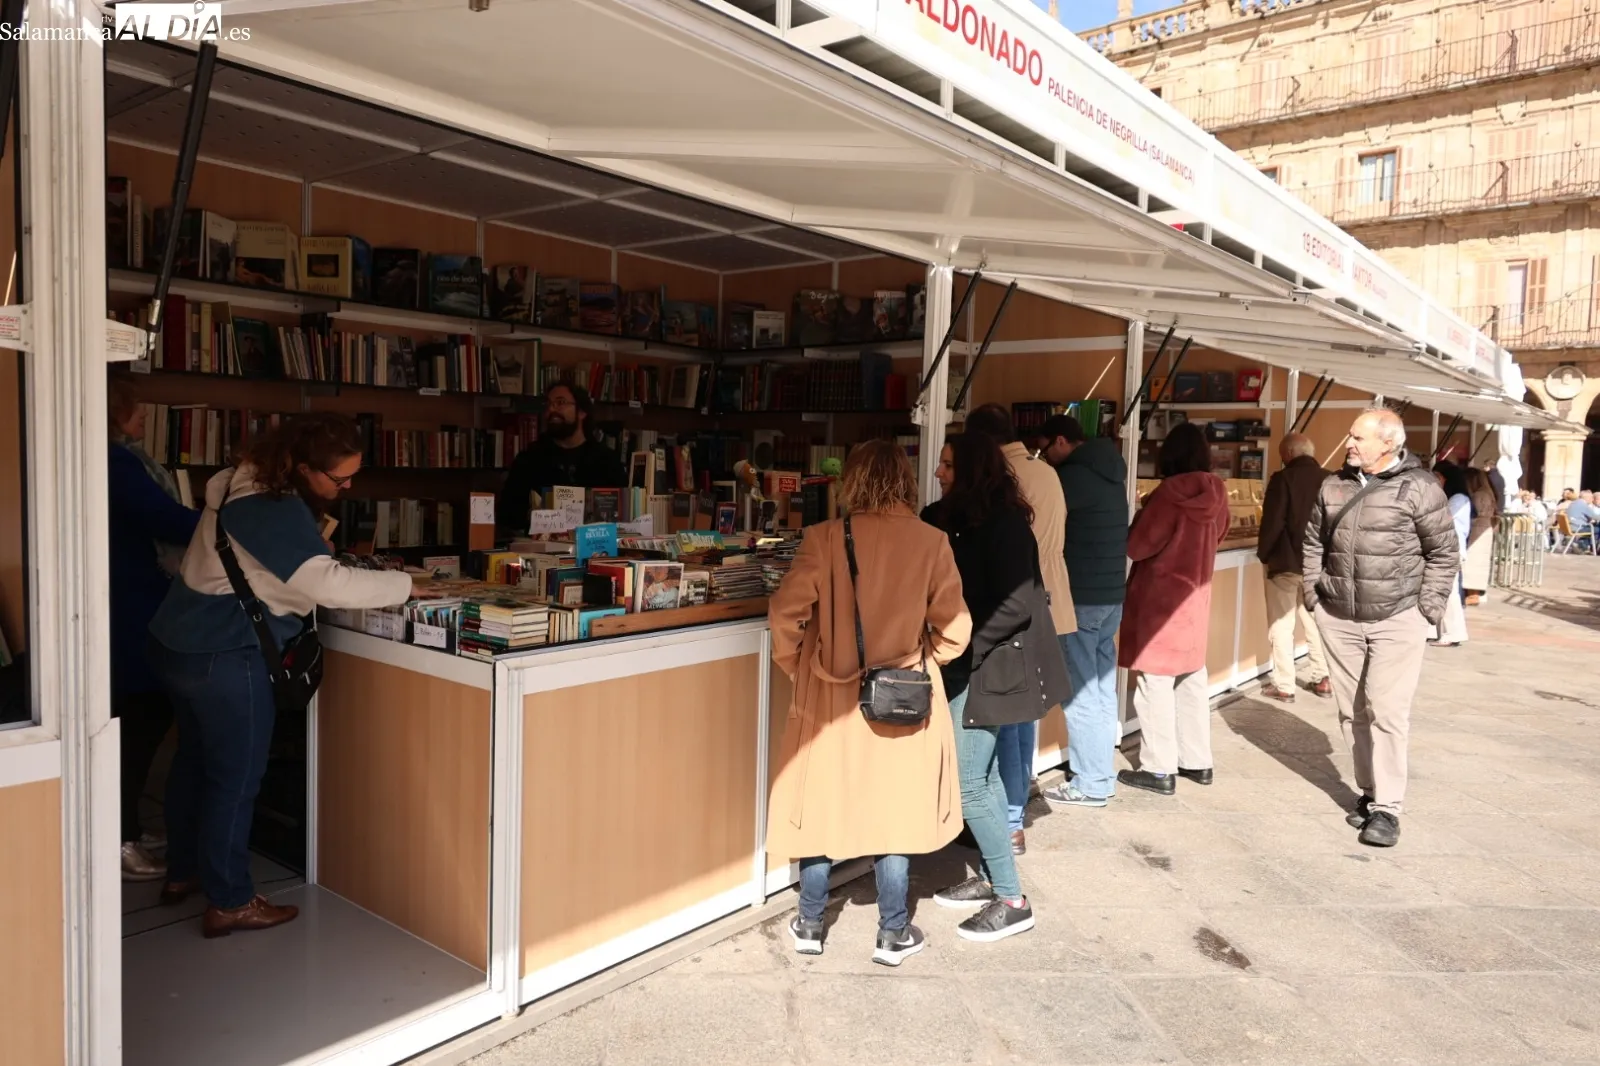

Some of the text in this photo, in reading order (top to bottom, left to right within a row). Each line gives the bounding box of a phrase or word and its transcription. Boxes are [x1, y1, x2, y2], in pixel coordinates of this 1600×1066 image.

[1048, 77, 1095, 121] PALENCIA
[1096, 108, 1108, 130] DE
[1109, 117, 1148, 155] NEGRILLA
[1149, 143, 1196, 186] (SALAMANCA)
